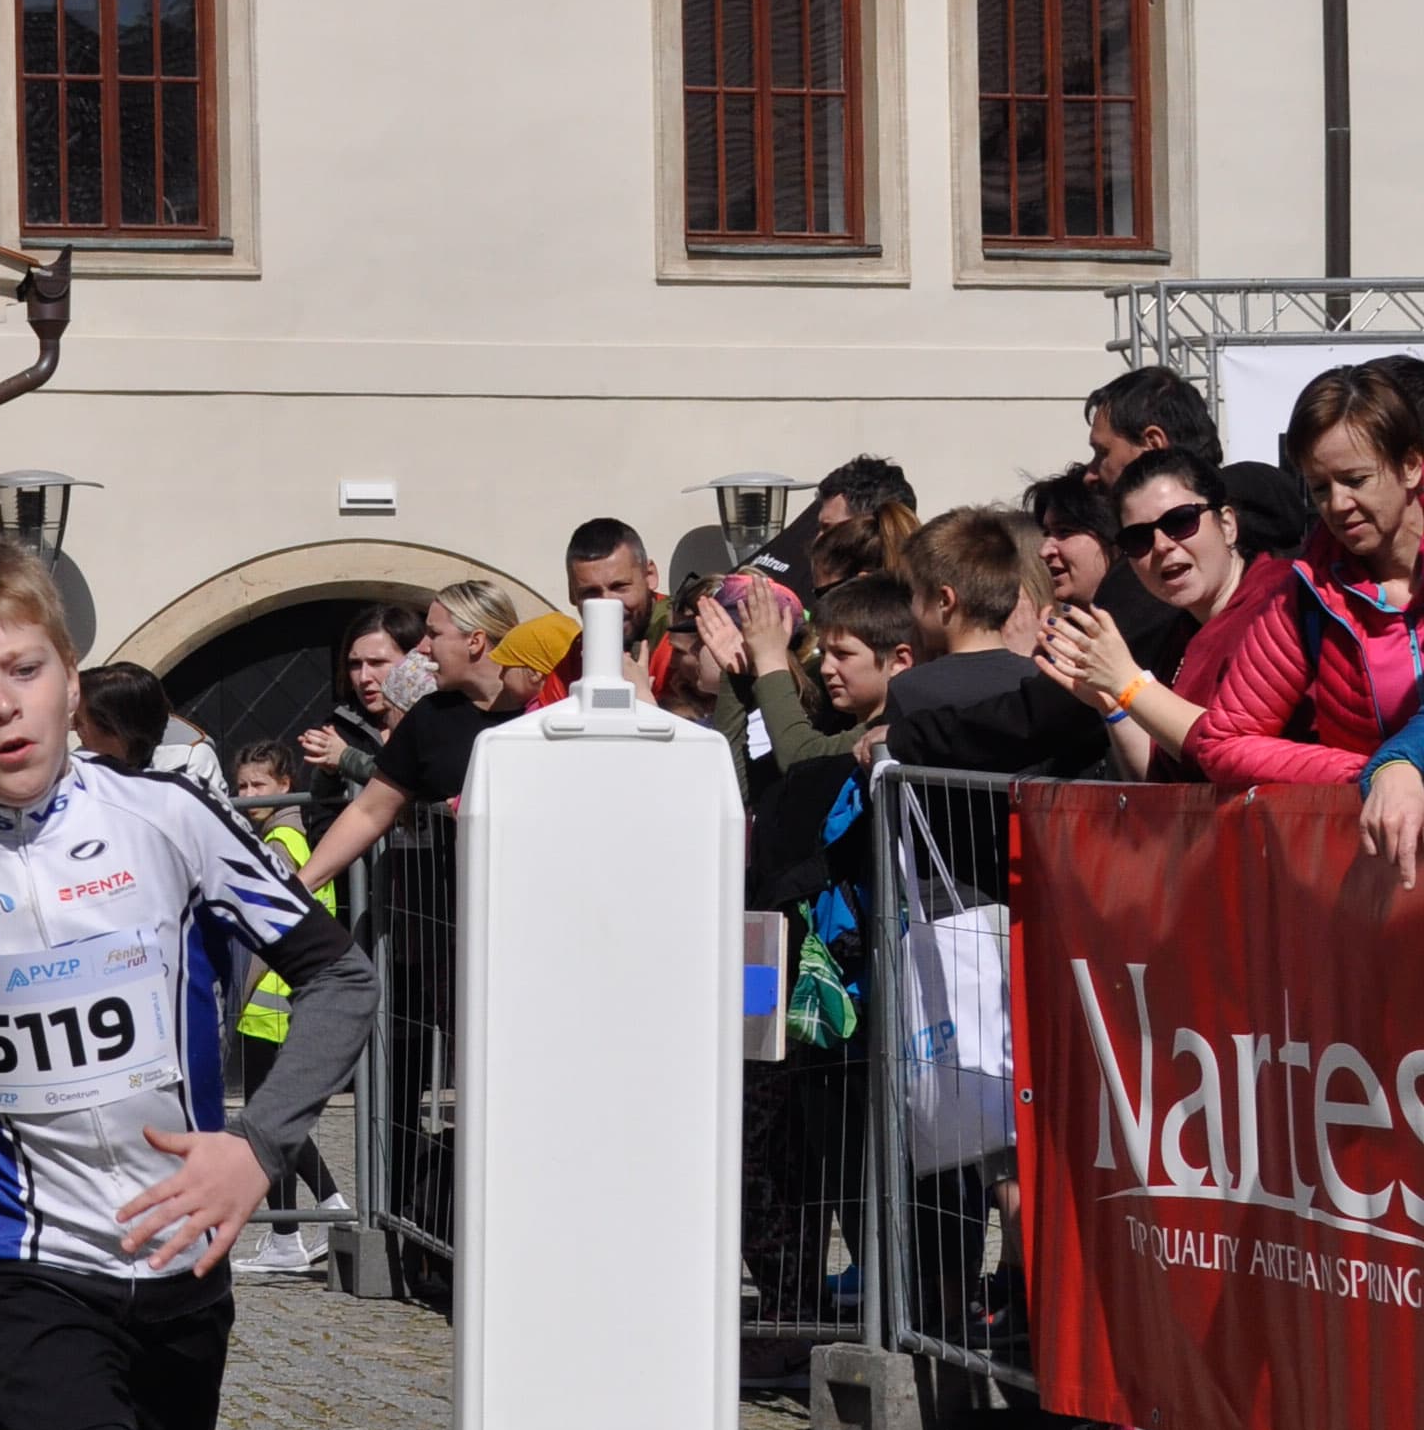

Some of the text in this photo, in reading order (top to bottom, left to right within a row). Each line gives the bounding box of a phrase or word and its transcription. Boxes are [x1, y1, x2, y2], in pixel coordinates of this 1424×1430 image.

[75, 870, 135, 898] PENTA
[29, 958, 80, 981] PVZP
[127, 954, 148, 968] run
[59, 1088, 99, 1101] Centrum
[1152, 1225, 1240, 1273] QUALITY
[1249, 1239, 1333, 1293] ARTEIAN
[1336, 1258, 1423, 1308] SPRING
